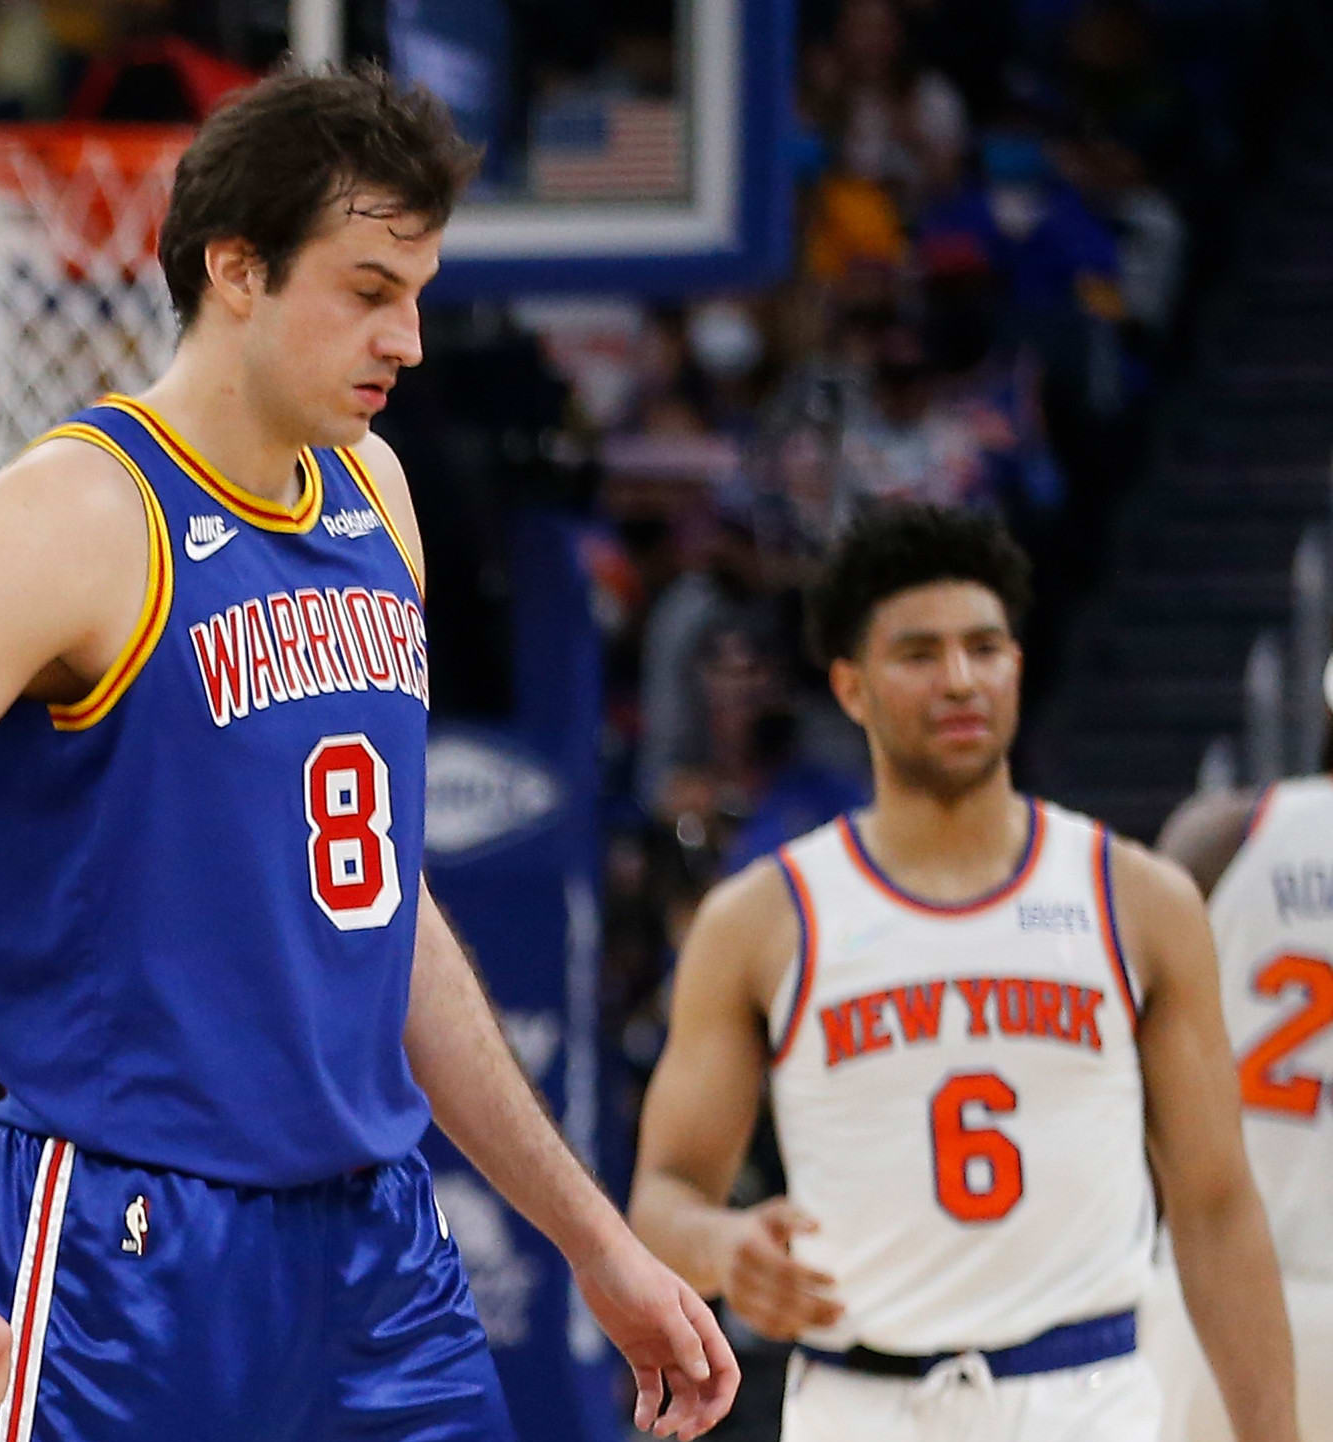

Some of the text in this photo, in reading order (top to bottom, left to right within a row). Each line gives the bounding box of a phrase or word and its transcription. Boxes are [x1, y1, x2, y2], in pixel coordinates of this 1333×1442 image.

[189, 515, 226, 542] NIKE
[189, 587, 430, 728] WARRIORS
[304, 732, 402, 931] 8
[819, 977, 1104, 1067] NEW YORK
[1237, 952, 1333, 1117] 2
[930, 1070, 1023, 1224] 6
